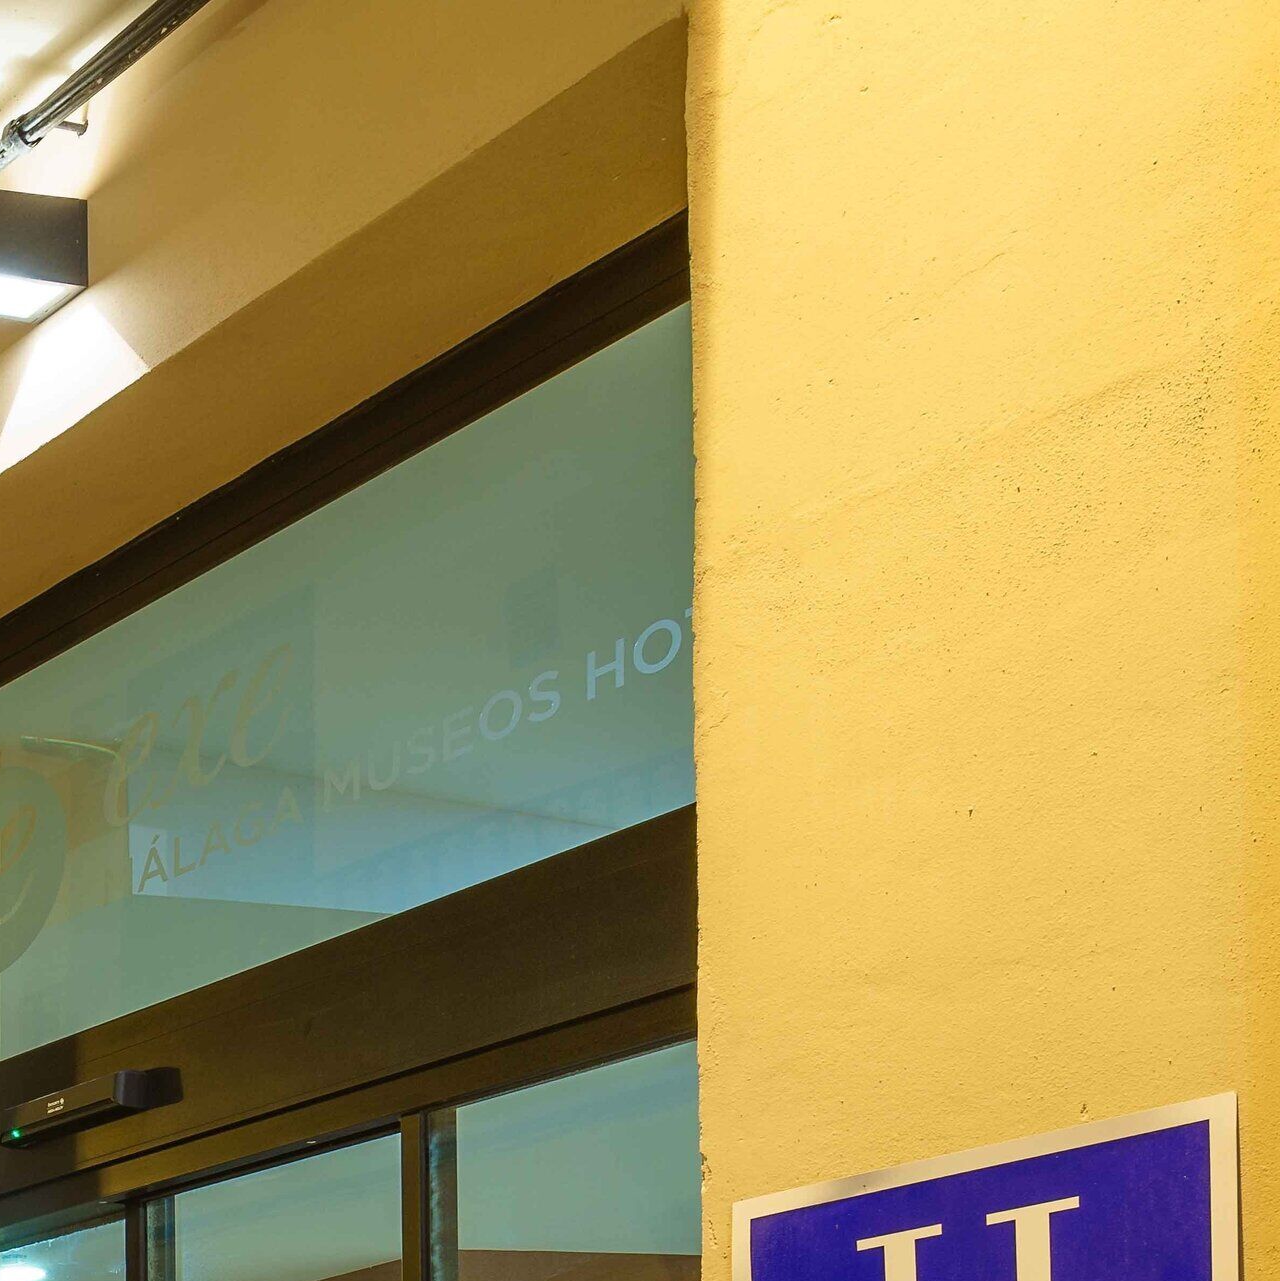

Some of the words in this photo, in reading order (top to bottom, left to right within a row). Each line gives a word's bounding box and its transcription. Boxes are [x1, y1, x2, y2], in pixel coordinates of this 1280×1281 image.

[129, 785, 306, 894] ÁLAGA
[321, 669, 560, 808] MUSEOS
[586, 608, 693, 701] HO
